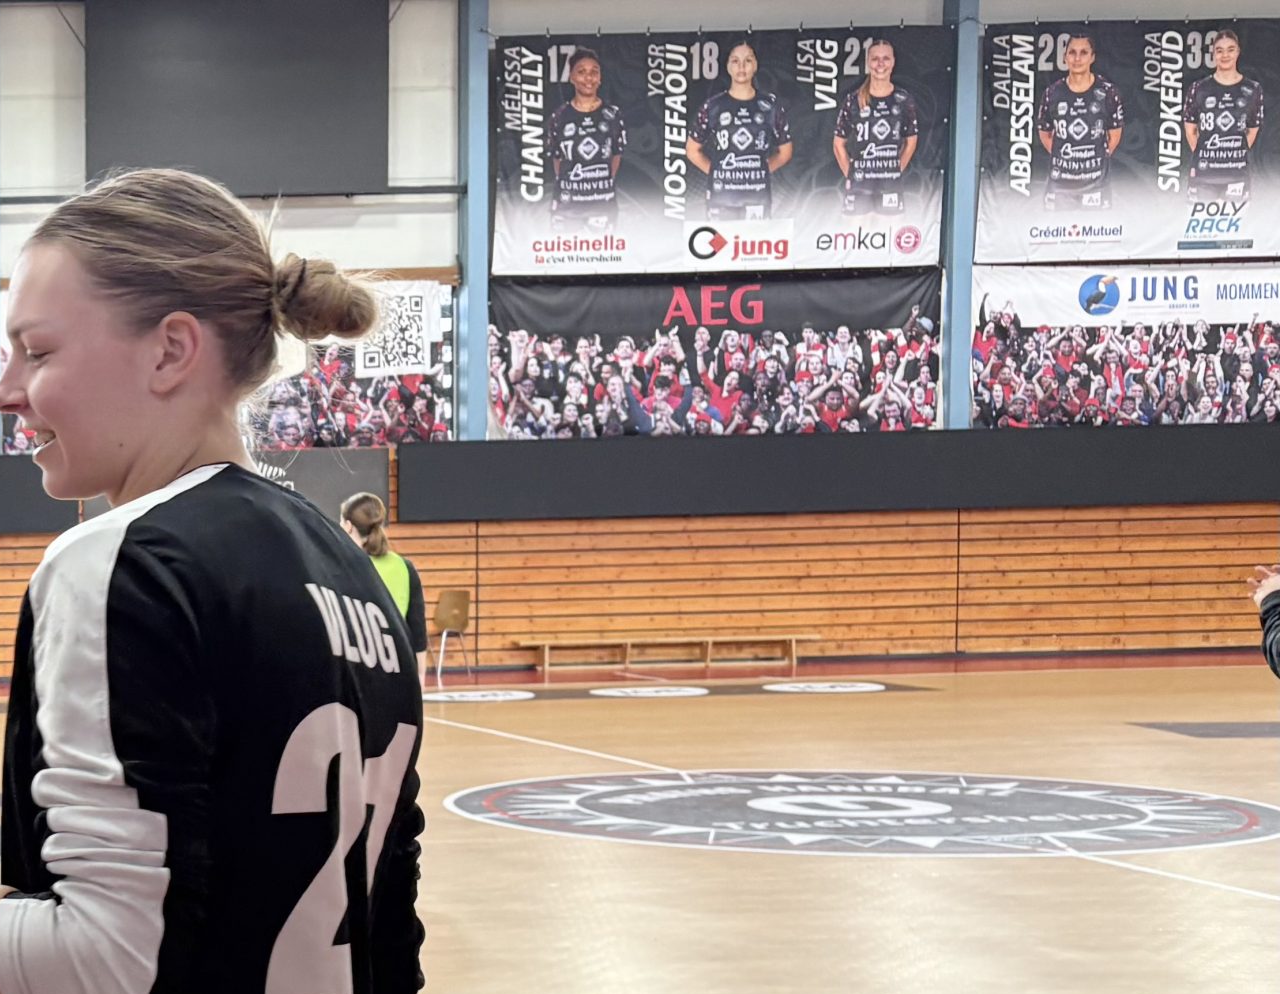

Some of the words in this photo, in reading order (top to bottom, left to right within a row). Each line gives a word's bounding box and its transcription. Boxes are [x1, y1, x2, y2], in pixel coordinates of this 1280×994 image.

[547, 45, 577, 84] 17
[648, 43, 665, 97] YOSR
[690, 41, 719, 80] 18
[796, 38, 815, 84] LISA
[993, 34, 1011, 110] DALILA
[1143, 31, 1162, 94] NORA
[1186, 31, 1218, 69] 33
[502, 45, 522, 132] MÉLISSA
[814, 38, 839, 111] VLUG
[520, 46, 543, 203] CHANTELLY
[664, 43, 688, 221] MOSTEFAOUI
[1009, 34, 1035, 197] ABDESSELAM
[1157, 30, 1184, 193] SNEDKERUD
[1029, 225, 1067, 239] Crédit
[1081, 224, 1123, 237] Mutuel
[1185, 217, 1242, 233] RACK
[1191, 201, 1248, 217] POLY
[532, 235, 627, 252] cuisinella
[731, 235, 789, 261] jung
[816, 226, 887, 251] emka
[662, 283, 765, 327] AEG
[1127, 275, 1200, 302] JUNG
[305, 582, 401, 674] VLUG
